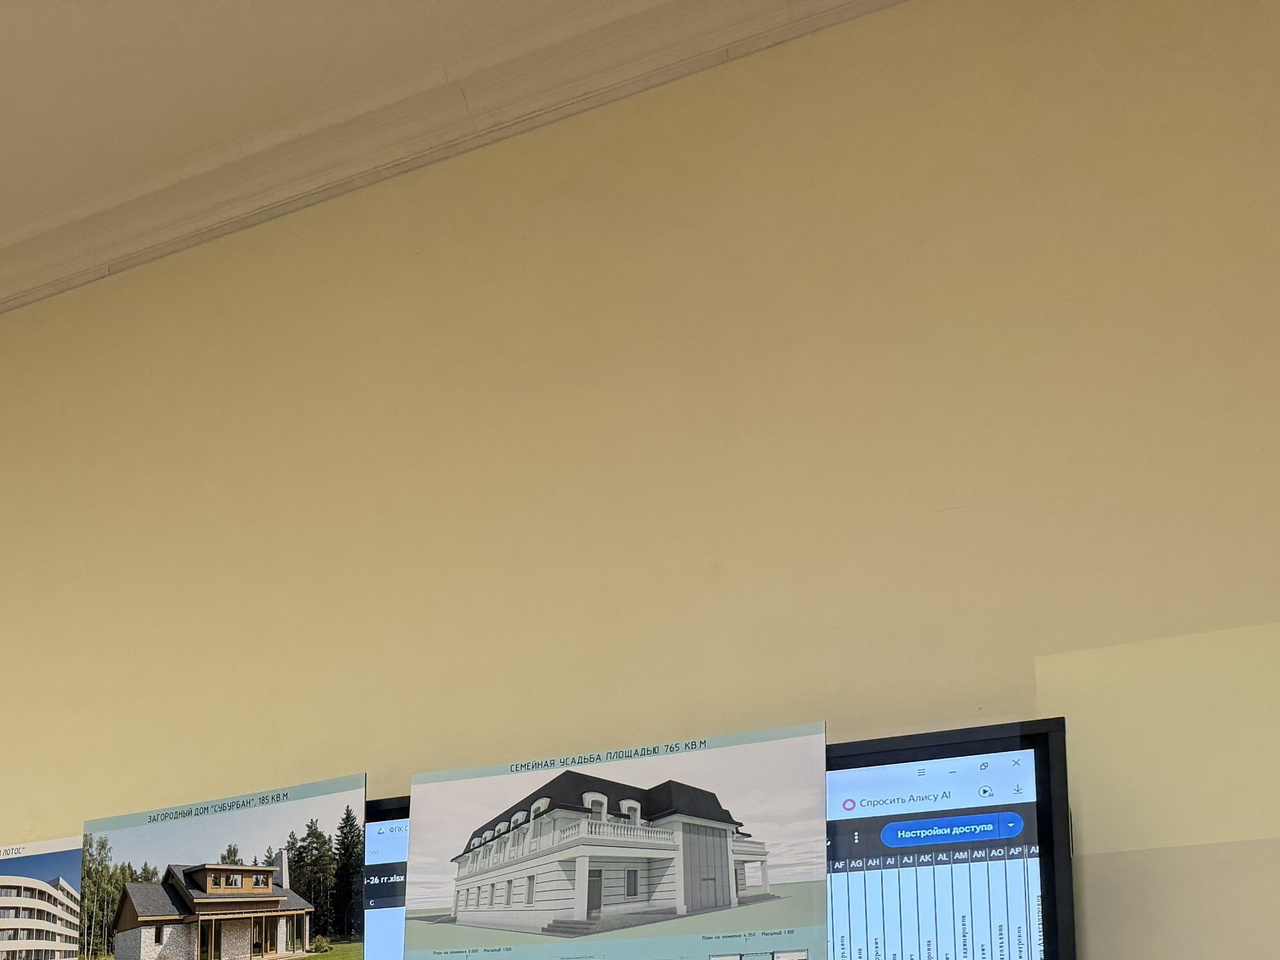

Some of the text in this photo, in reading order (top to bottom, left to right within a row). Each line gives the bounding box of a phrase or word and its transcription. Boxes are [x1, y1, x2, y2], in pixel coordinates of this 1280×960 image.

[510, 759, 555, 772] СЕМЕЙНАЯ
[560, 753, 601, 766] УСАДЬБА
[606, 746, 660, 761] ПЛОЩАДЬЮ
[664, 743, 680, 753] 765
[148, 808, 193, 823] ЗАГОРОДНЫЙ
[194, 806, 209, 817] ДОМ
[259, 796, 270, 805] 185
[860, 791, 951, 809] Спросить Алису AI
[897, 823, 993, 839] Настройки доступа
[834, 847, 1022, 869] AF AG AH AI AJ AK AL AM AN AO AP
